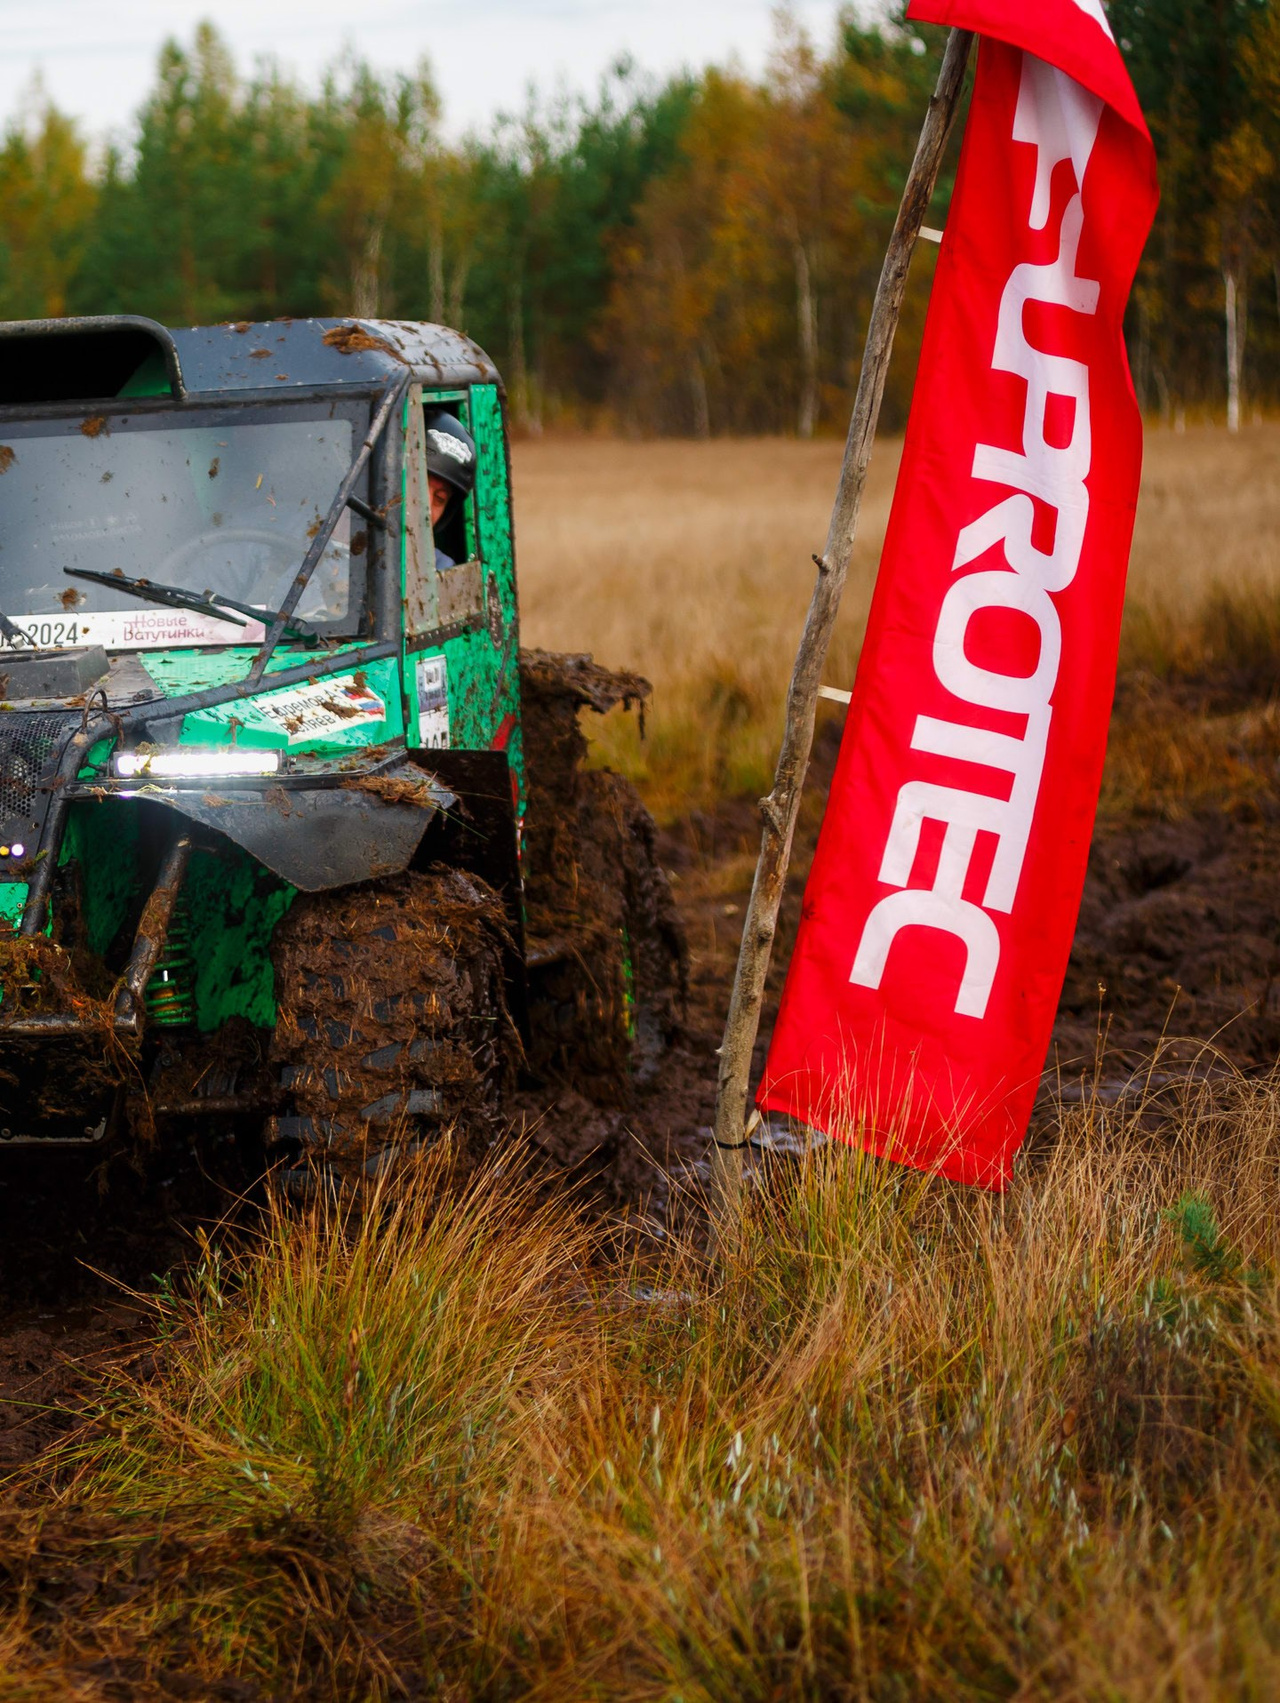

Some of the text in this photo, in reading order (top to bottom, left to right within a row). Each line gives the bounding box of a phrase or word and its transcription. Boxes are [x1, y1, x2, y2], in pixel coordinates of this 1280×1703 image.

[124, 614, 187, 629] Новые
[28, 621, 78, 646] 2024
[124, 626, 204, 643] Ватутинки
